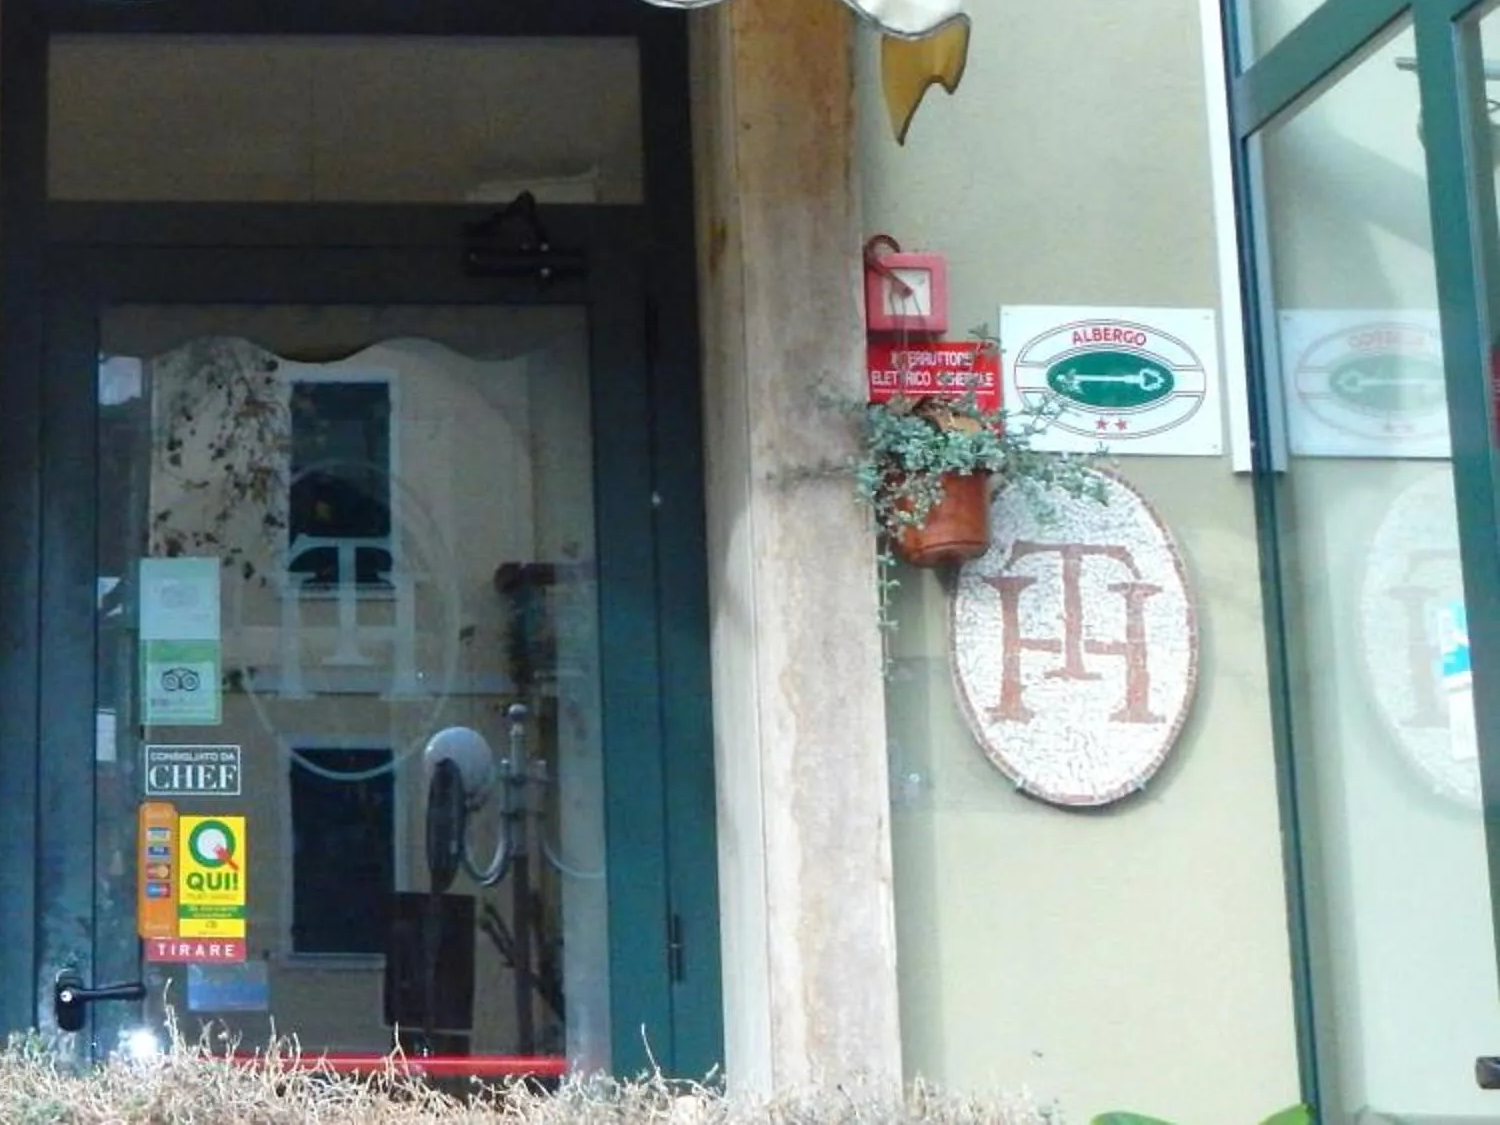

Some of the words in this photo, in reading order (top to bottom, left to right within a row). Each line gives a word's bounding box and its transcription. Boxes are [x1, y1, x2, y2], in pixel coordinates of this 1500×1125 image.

[1072, 326, 1147, 346] ALBERGO
[890, 350, 973, 366] IERRUTTORE
[871, 370, 931, 386] ELETRICO
[149, 764, 237, 789] CHEF
[186, 872, 239, 892] QUI!
[157, 943, 236, 957] TIRARE
